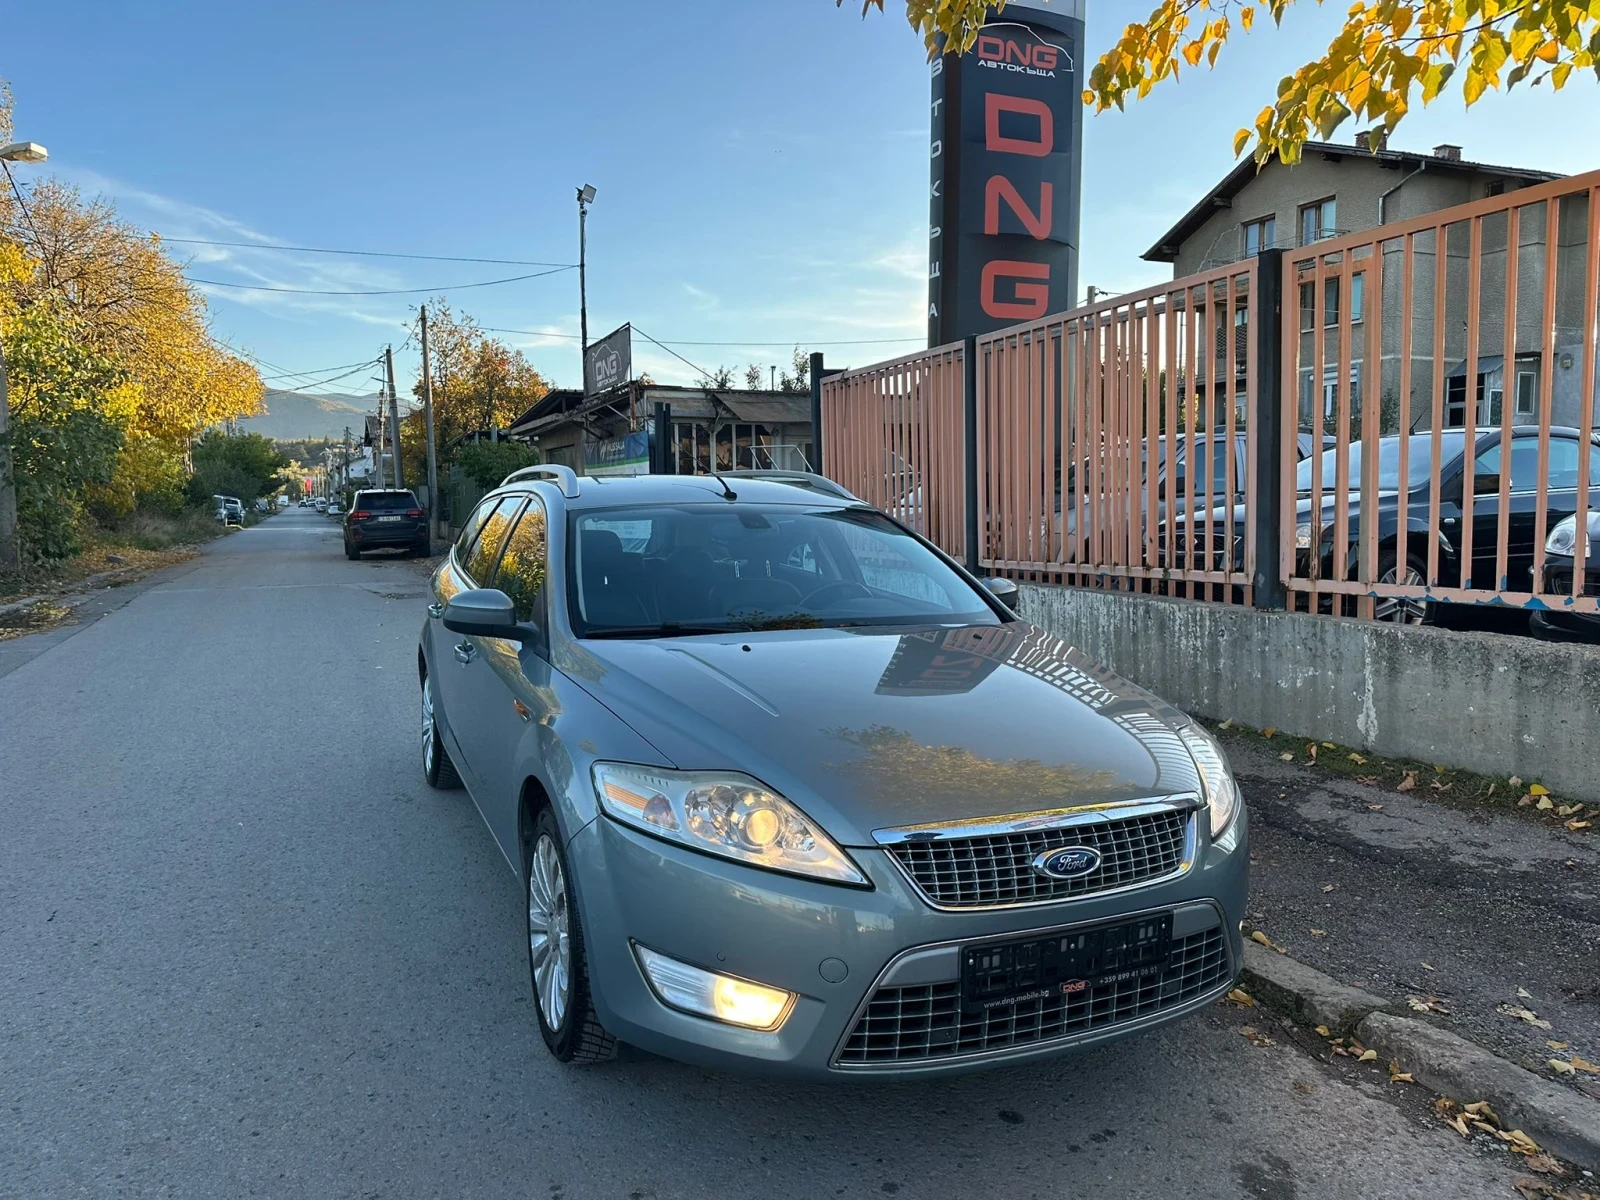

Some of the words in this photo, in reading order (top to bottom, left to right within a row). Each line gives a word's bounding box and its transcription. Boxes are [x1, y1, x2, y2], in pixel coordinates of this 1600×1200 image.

[978, 35, 1057, 69] DNG
[980, 92, 1054, 320] DNG
[595, 353, 617, 381] DNG
[1057, 854, 1088, 871] Ford
[1062, 981, 1086, 992] DNG
[1099, 975, 1116, 984] +359
[1117, 972, 1130, 981] 899
[983, 989, 1050, 1008] www.dng.mobile.bg
